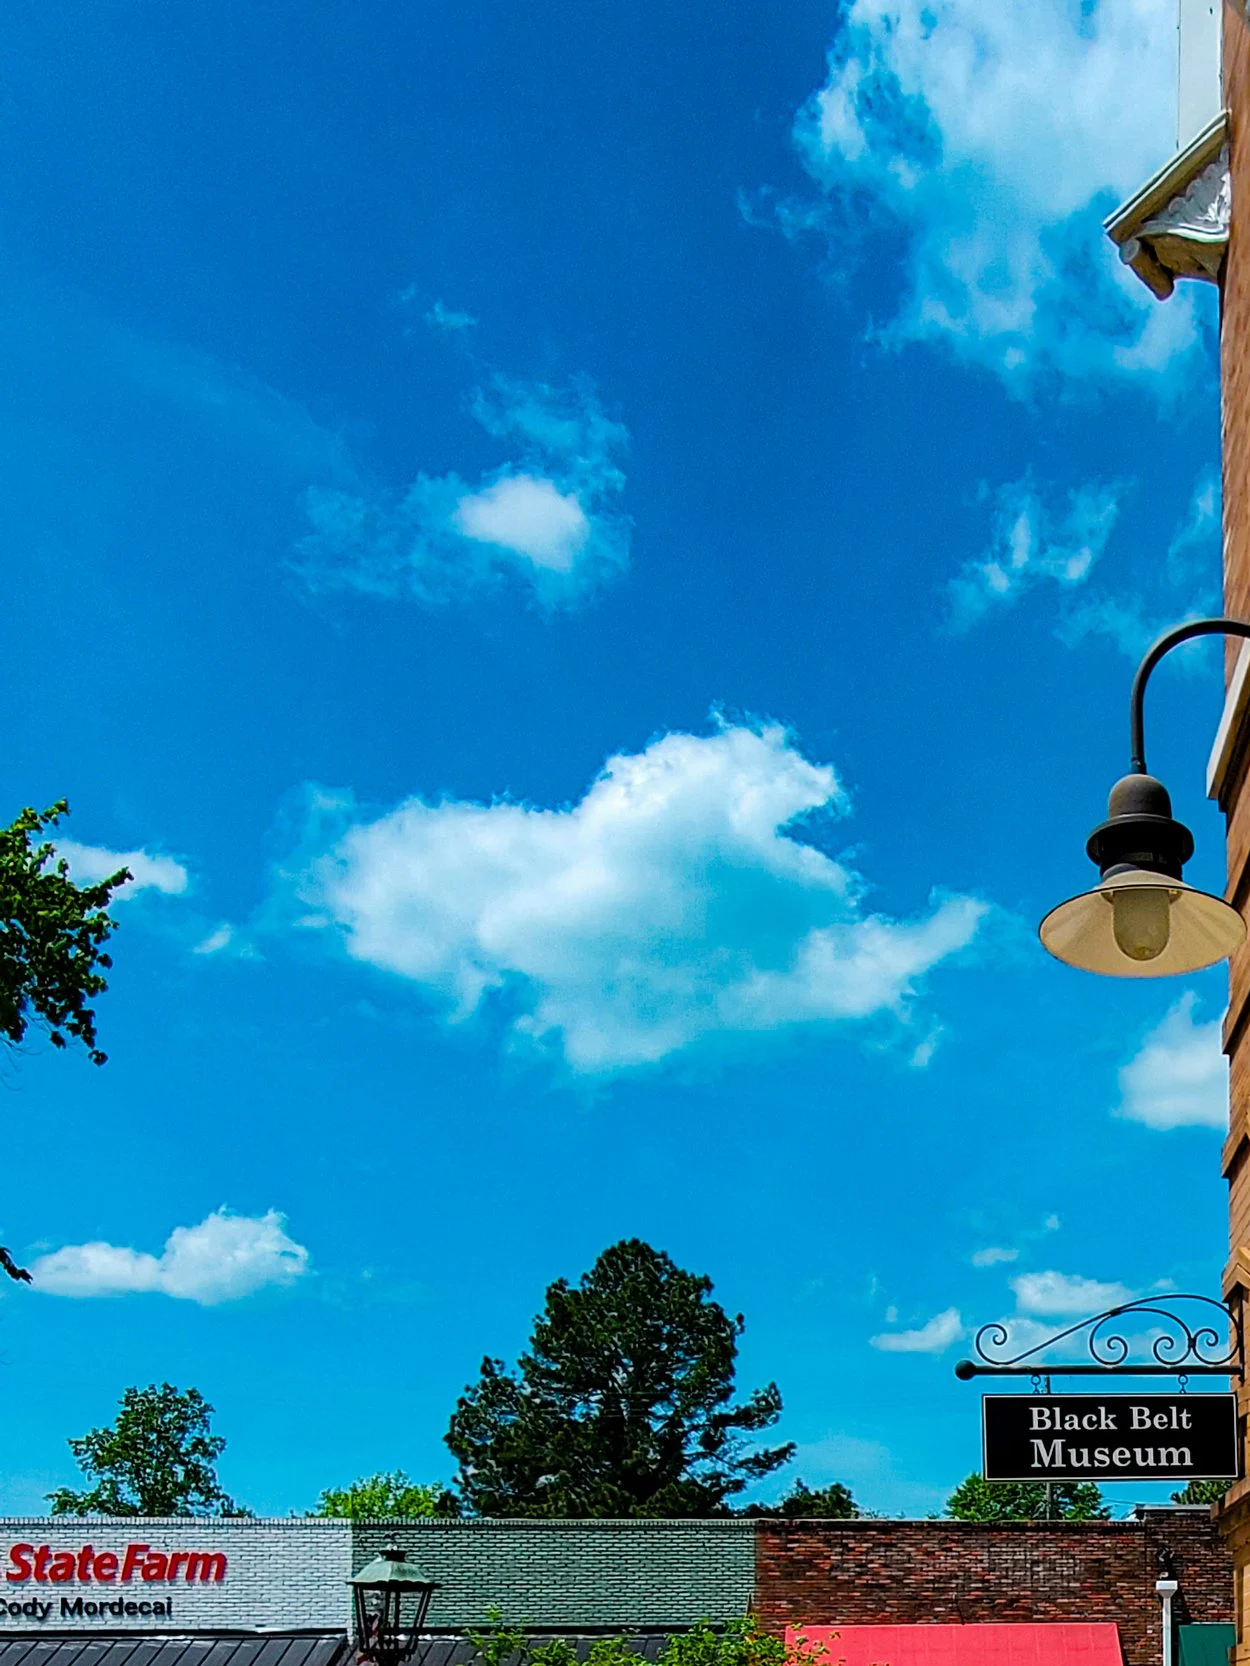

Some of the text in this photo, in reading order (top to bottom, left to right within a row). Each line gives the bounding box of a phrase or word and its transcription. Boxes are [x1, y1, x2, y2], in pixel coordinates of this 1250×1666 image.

[1029, 1406, 1192, 1430] Black Belt
[1030, 1439, 1194, 1468] Museum
[60, 1597, 172, 1616] Mordecai
